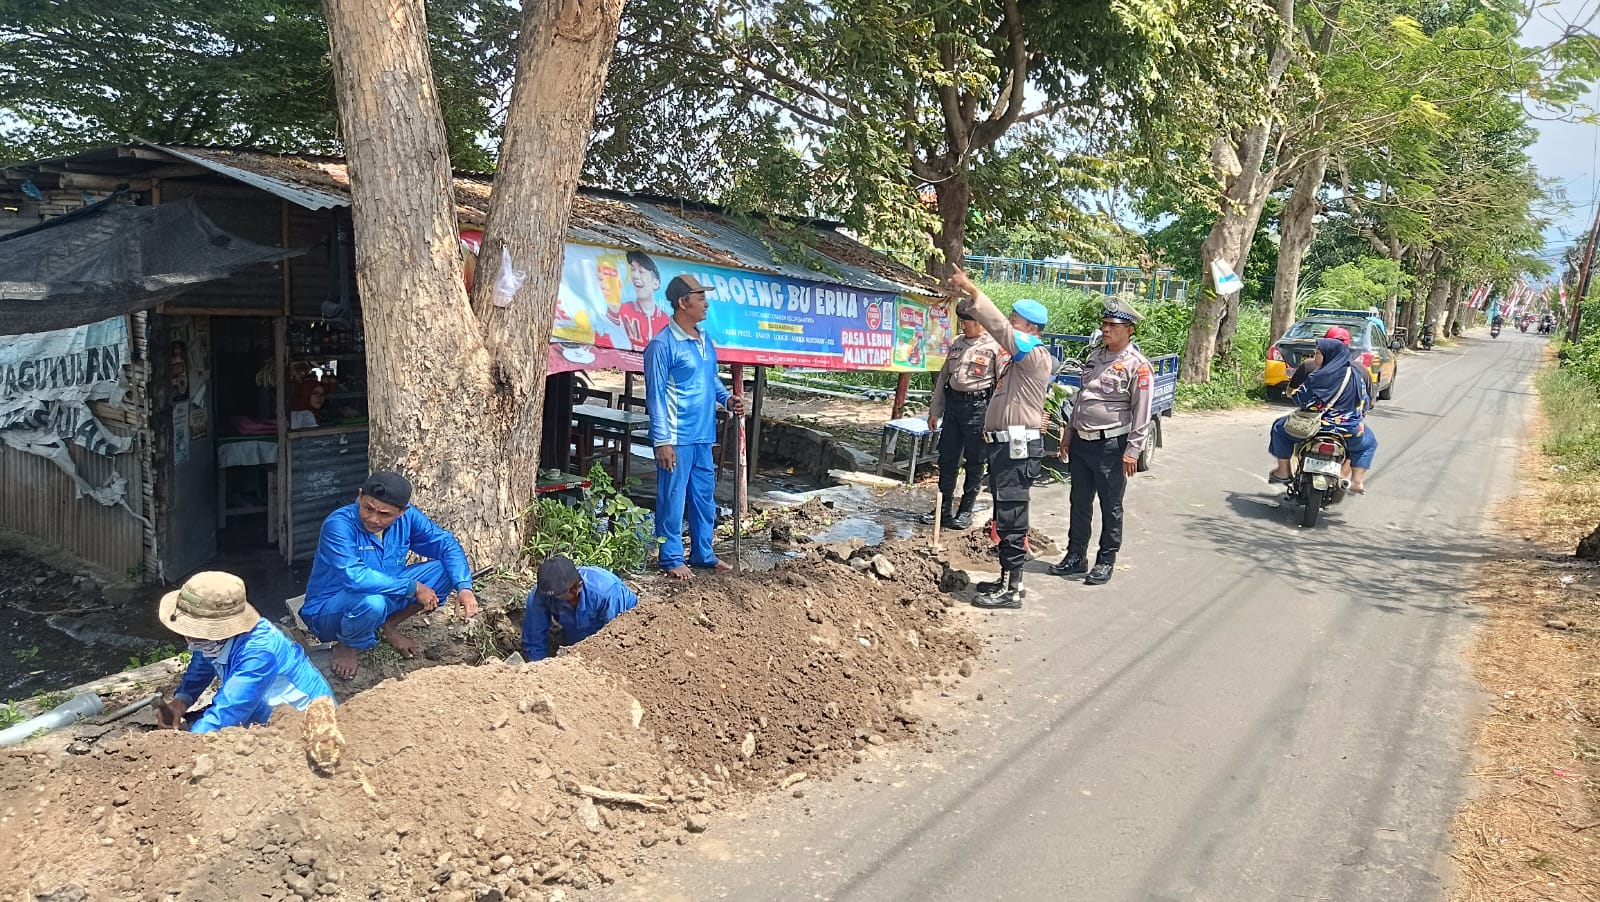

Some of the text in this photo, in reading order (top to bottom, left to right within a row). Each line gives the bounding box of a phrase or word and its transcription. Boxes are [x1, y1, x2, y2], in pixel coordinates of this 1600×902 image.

[680, 271, 858, 318] AROENG BU ERNA
[842, 331, 865, 346] RASA
[867, 332, 891, 348] LEBIH
[843, 348, 890, 364] MANTAP!
